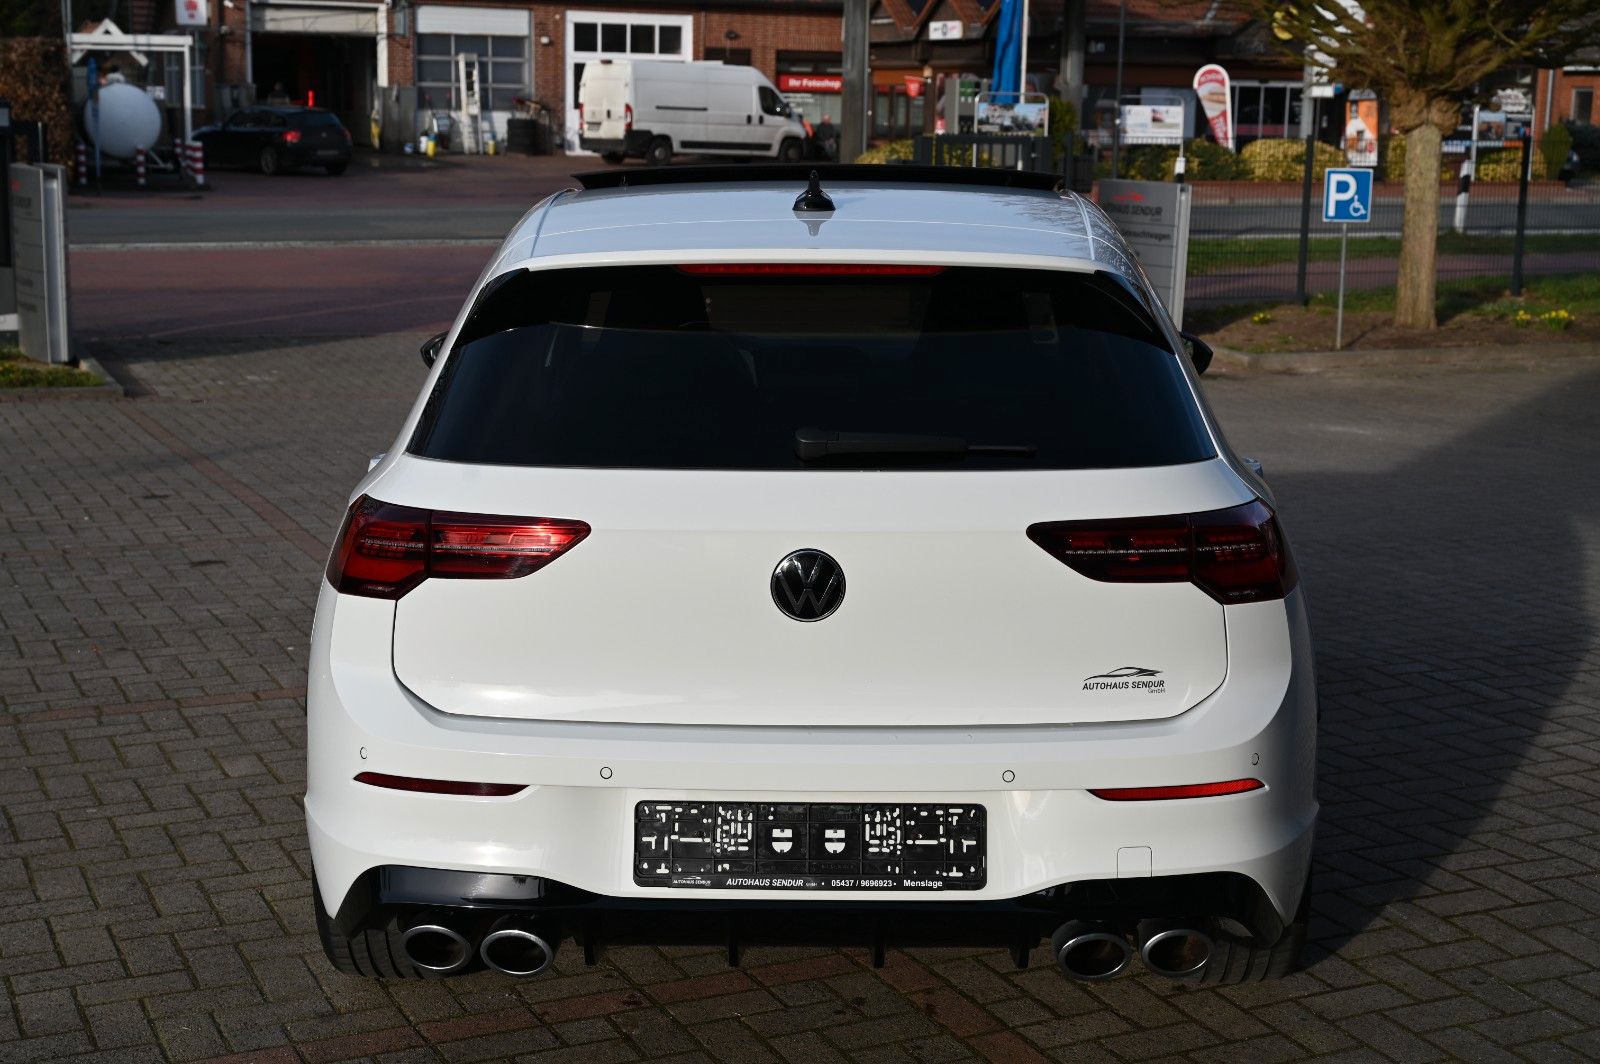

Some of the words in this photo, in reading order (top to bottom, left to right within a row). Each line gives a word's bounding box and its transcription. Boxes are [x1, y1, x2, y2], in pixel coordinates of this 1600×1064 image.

[1327, 173, 1357, 217] P
[1082, 681, 1130, 690] AUTOHAUS
[1131, 680, 1165, 688] SENDUR
[726, 878, 770, 886] AUTOHAUS
[771, 878, 803, 887] SENDUR
[831, 879, 854, 887] 05437
[860, 879, 892, 887] 9696923
[903, 879, 943, 889] Menslage
